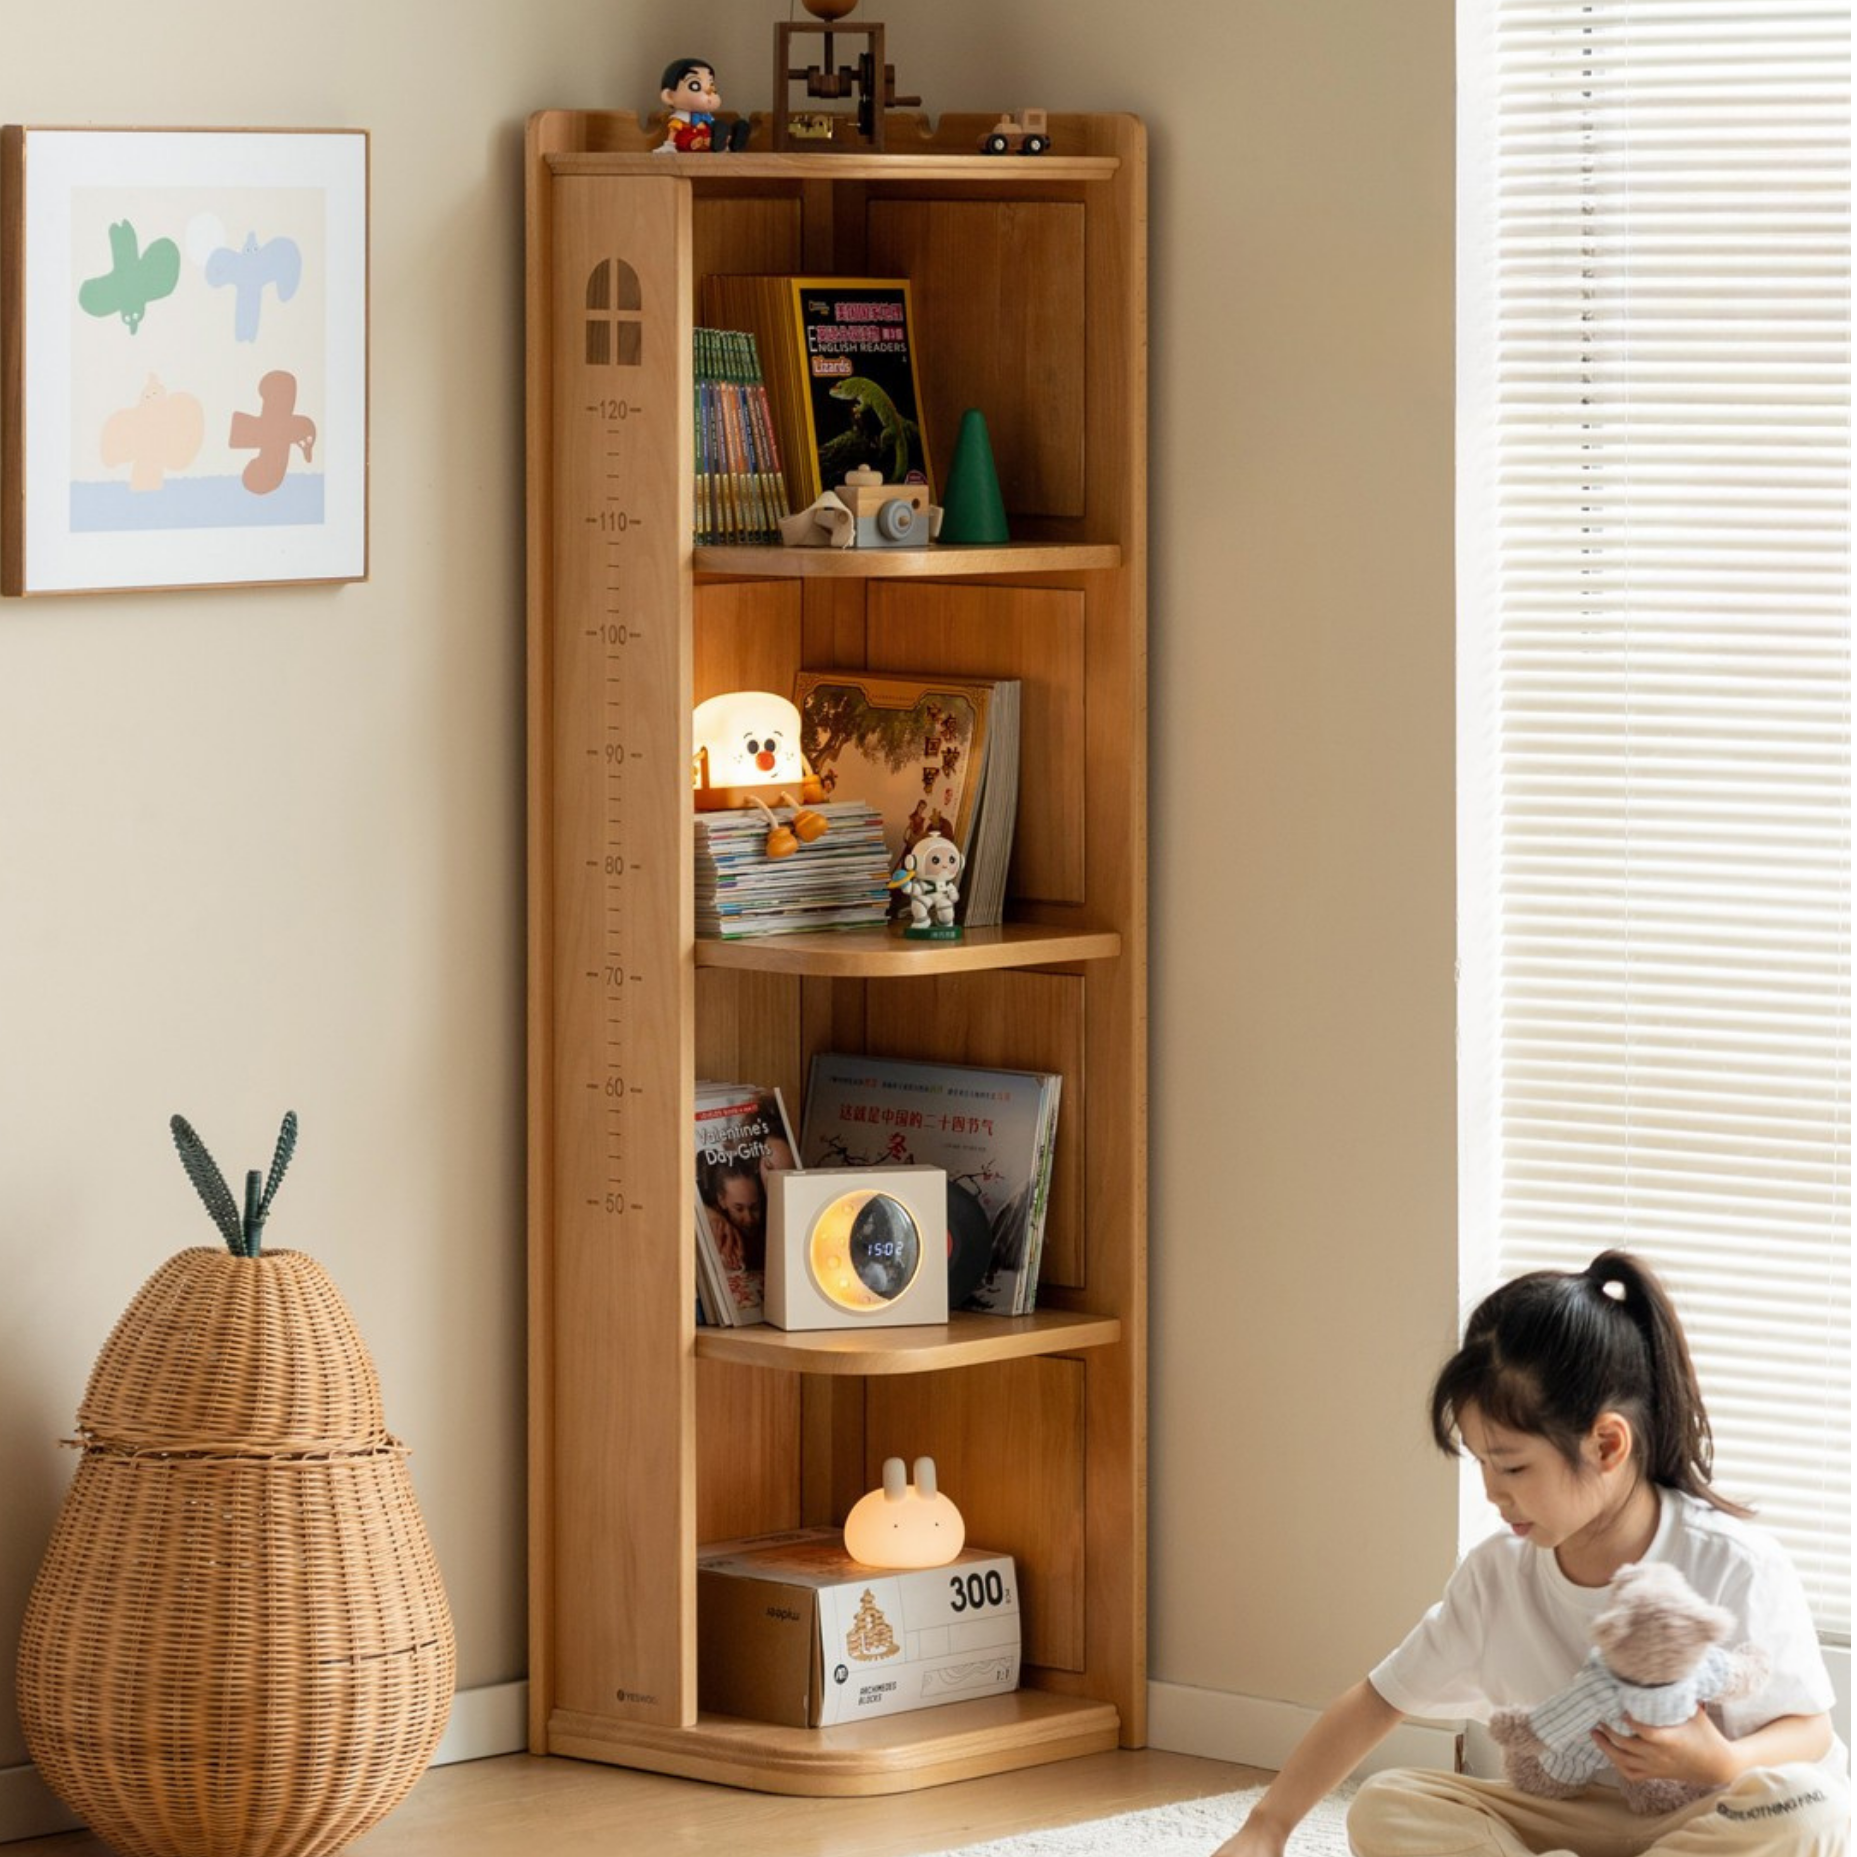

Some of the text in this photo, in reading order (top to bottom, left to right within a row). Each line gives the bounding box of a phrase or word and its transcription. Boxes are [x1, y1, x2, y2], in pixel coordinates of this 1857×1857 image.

[860, 342, 907, 352] READERS
[814, 356, 851, 373] Lizards
[599, 400, 627, 420] 120
[599, 512, 627, 532] 110
[599, 625, 627, 645] 100
[605, 744, 625, 765] 90
[605, 855, 624, 875] 80
[605, 966, 624, 986] 70
[605, 1077, 624, 1097] 60
[839, 1104, 994, 1136] 这就是中国的二十四节气
[697, 1118, 770, 1145] Valentine's
[887, 1132, 907, 1160] 冬
[605, 1193, 624, 1215] 50
[950, 1570, 1003, 1612] 300
